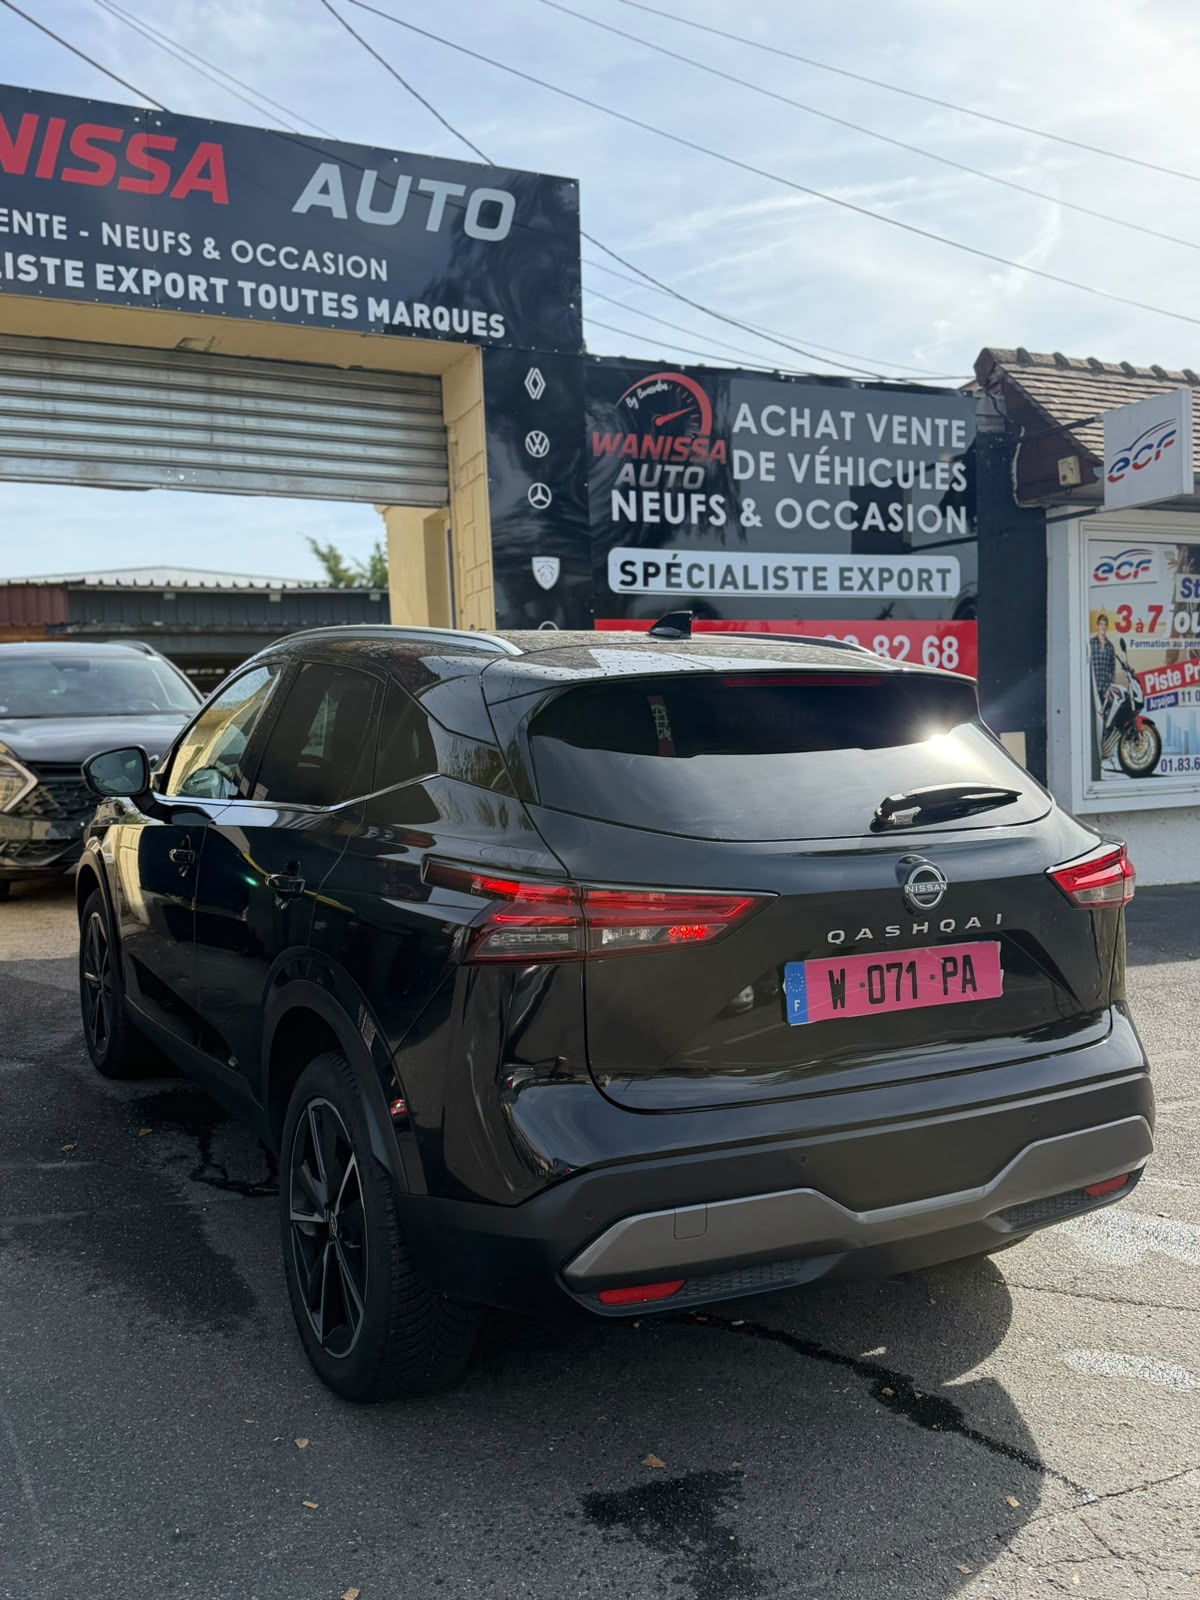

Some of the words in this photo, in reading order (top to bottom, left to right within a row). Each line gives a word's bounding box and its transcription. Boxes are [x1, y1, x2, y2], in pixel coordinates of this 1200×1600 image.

[292, 162, 516, 242] AUTO
[102, 222, 192, 256] NEUFS
[203, 237, 221, 260] &
[231, 240, 388, 282] OCCASION
[0, 252, 85, 288] ISTE
[96, 263, 229, 304] EXPORT
[238, 281, 358, 320] TOUTES
[368, 297, 505, 338] MARQUES
[732, 403, 855, 441] ACHAT
[866, 413, 966, 449] VENTE
[592, 431, 727, 464] WANISSA
[614, 462, 705, 489] AUTO
[733, 449, 776, 482] DE
[787, 446, 967, 492] VÉHICULES
[611, 489, 726, 527] NEUFS
[740, 498, 763, 527] &
[775, 498, 966, 534] OCCASION
[619, 553, 828, 592] SPÉCIALISTE
[838, 566, 952, 592] EXPORT
[1115, 604, 1133, 634] 3
[1135, 618, 1144, 634] à
[1147, 604, 1164, 634] 7
[873, 634, 911, 662] 82
[922, 635, 960, 670] 68
[1130, 640, 1170, 648] Formation
[1144, 668, 1182, 694] Piste
[1184, 661, 1200, 683] Pr
[905, 882, 947, 893] NISSAN
[827, 913, 1003, 944] QASHQAI
[794, 1000, 801, 1012] F
